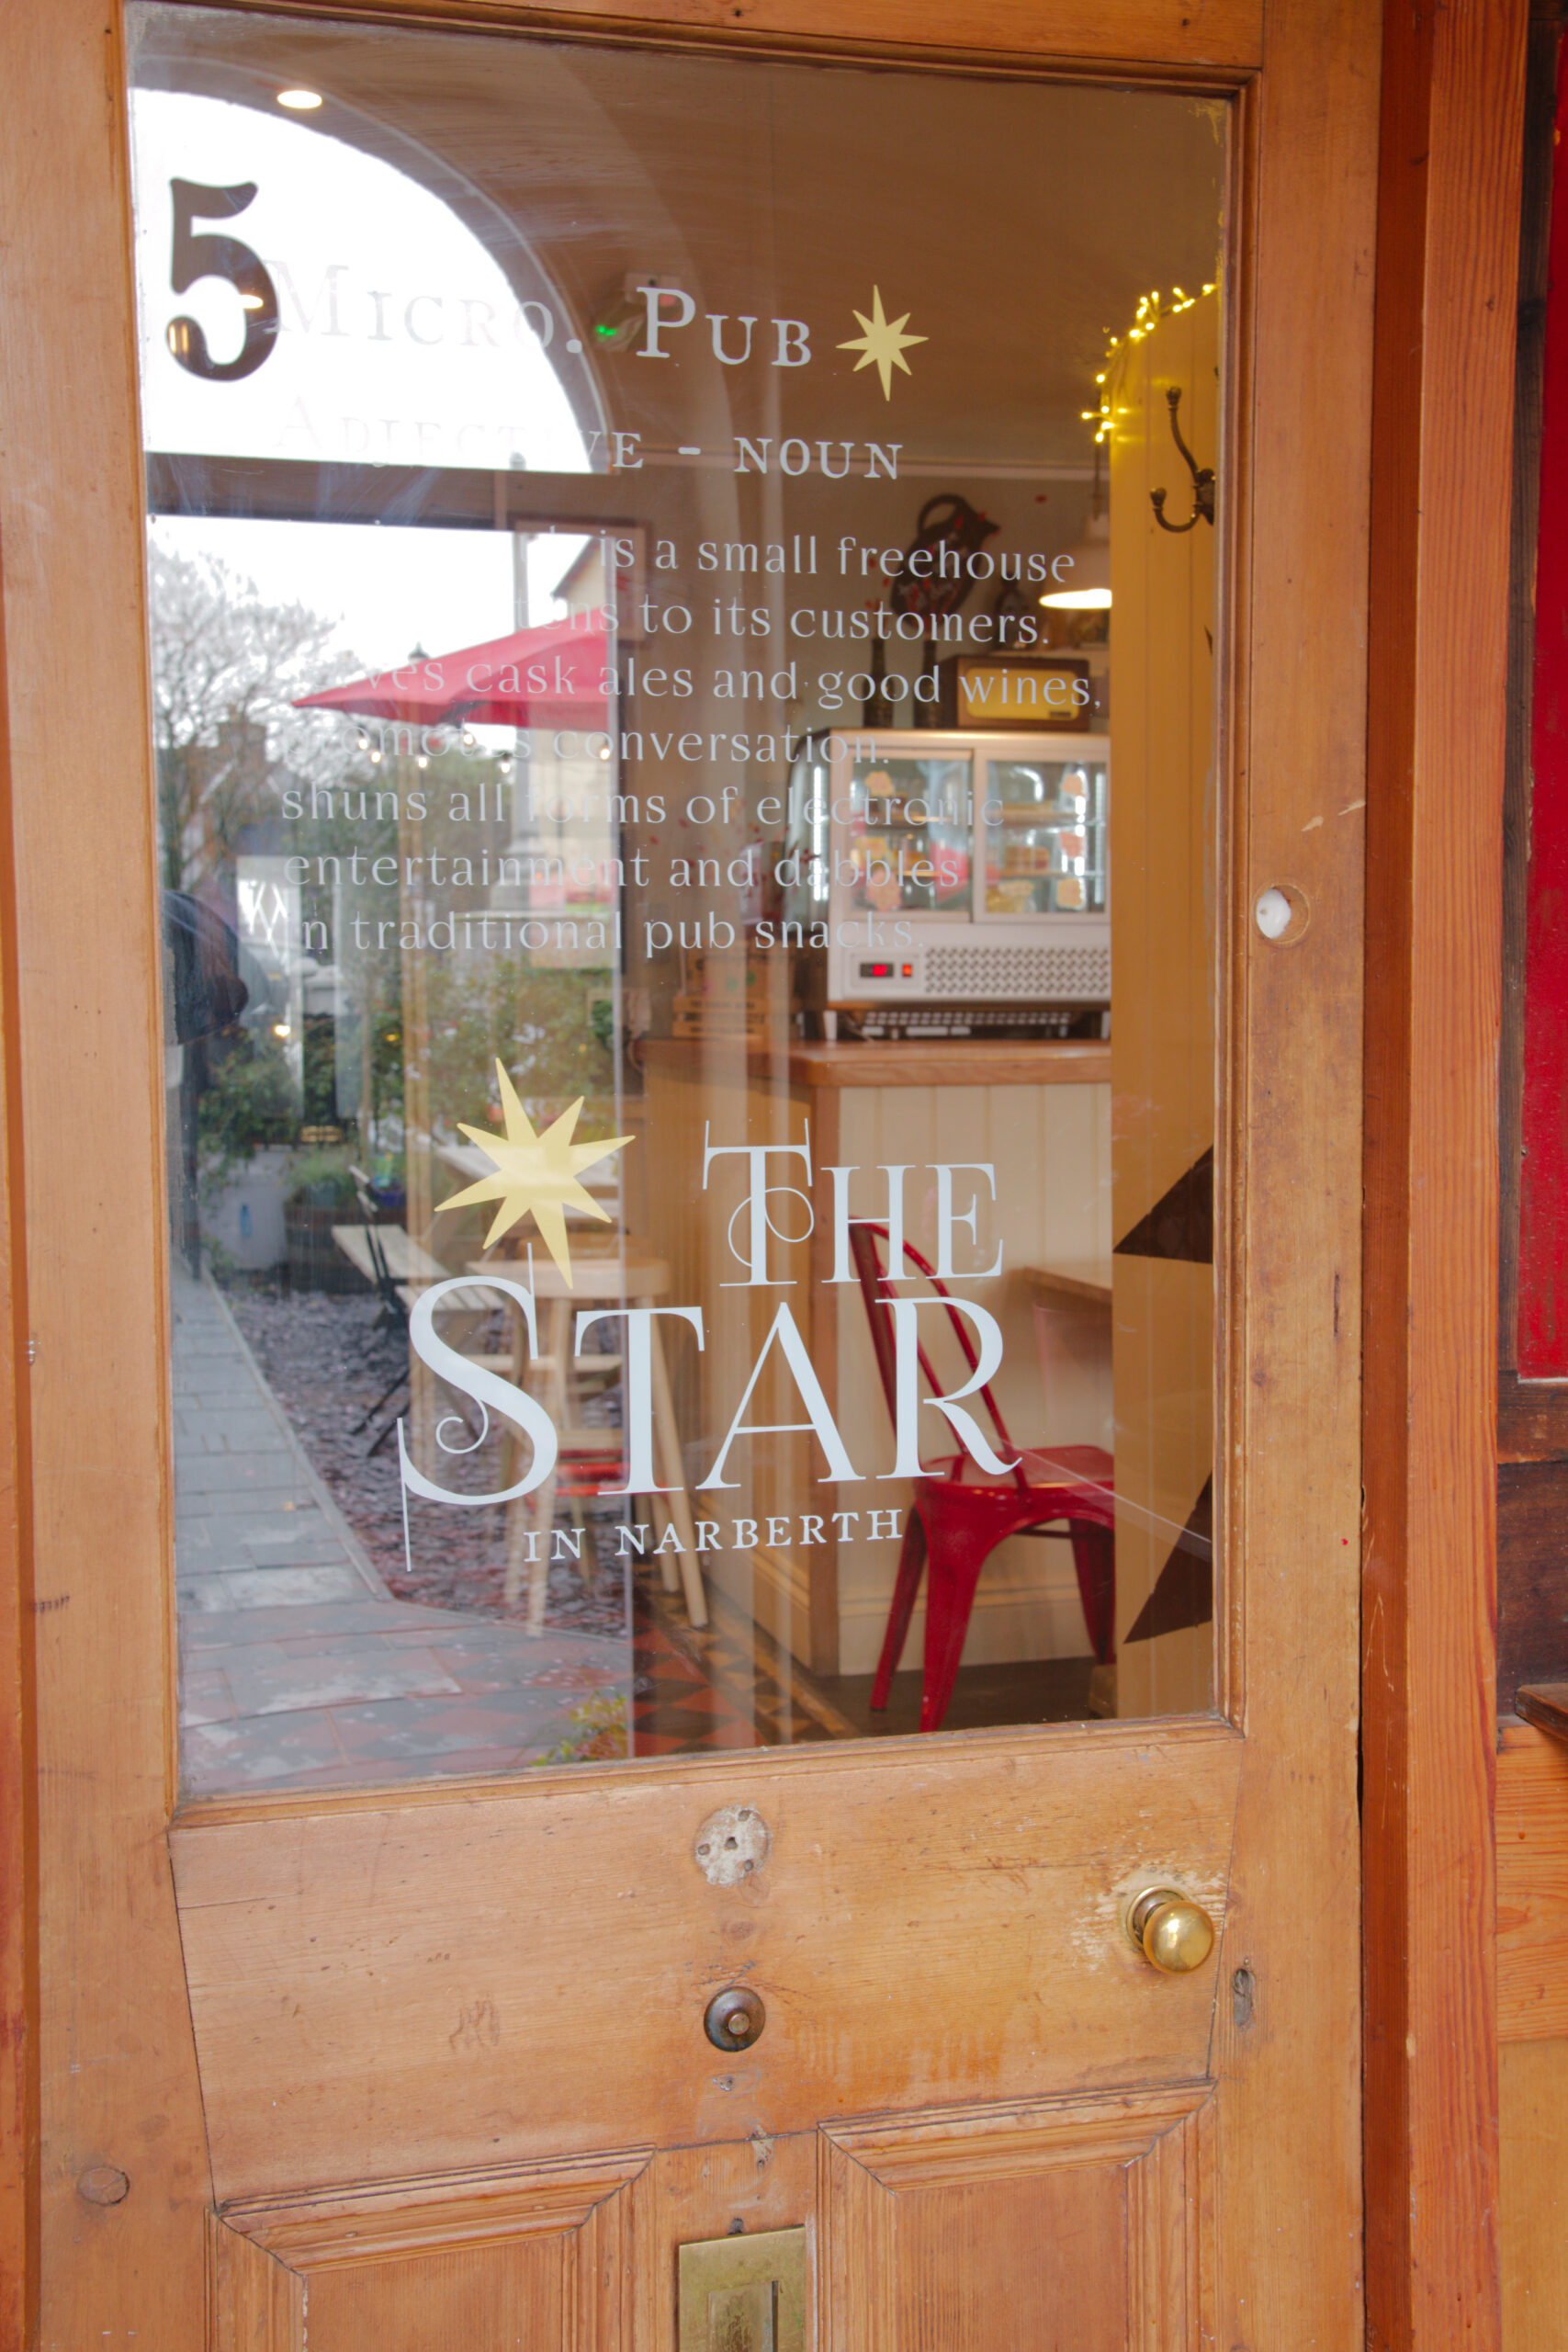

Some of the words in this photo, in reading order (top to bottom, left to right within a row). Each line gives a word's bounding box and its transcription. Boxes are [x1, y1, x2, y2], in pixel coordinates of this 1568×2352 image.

[164, 177, 280, 382] 5
[655, 537, 679, 571] a
[698, 535, 818, 574] small
[838, 536, 1077, 583] freehouse
[639, 594, 693, 635] to
[713, 598, 772, 639] its
[790, 600, 1050, 644] customers.
[466, 655, 577, 695] cask
[598, 657, 694, 697] ales
[713, 661, 798, 700] and
[818, 664, 941, 710] good
[959, 668, 1102, 710] wines,
[552, 724, 890, 767] conversation.
[281, 781, 428, 820] shuns
[448, 782, 505, 822] all
[525, 785, 667, 824] forms
[685, 786, 739, 825] of
[756, 786, 1005, 827] electronic
[283, 845, 650, 887] entertainment
[668, 847, 755, 888] and
[773, 848, 960, 888] dabbles
[349, 910, 623, 951] traditional
[644, 910, 736, 958] pub
[702, 1117, 1004, 1286] THE
[397, 1242, 1023, 1572] STAR
[523, 1528, 586, 1563] IN
[615, 1509, 904, 1556] NARBERTH
